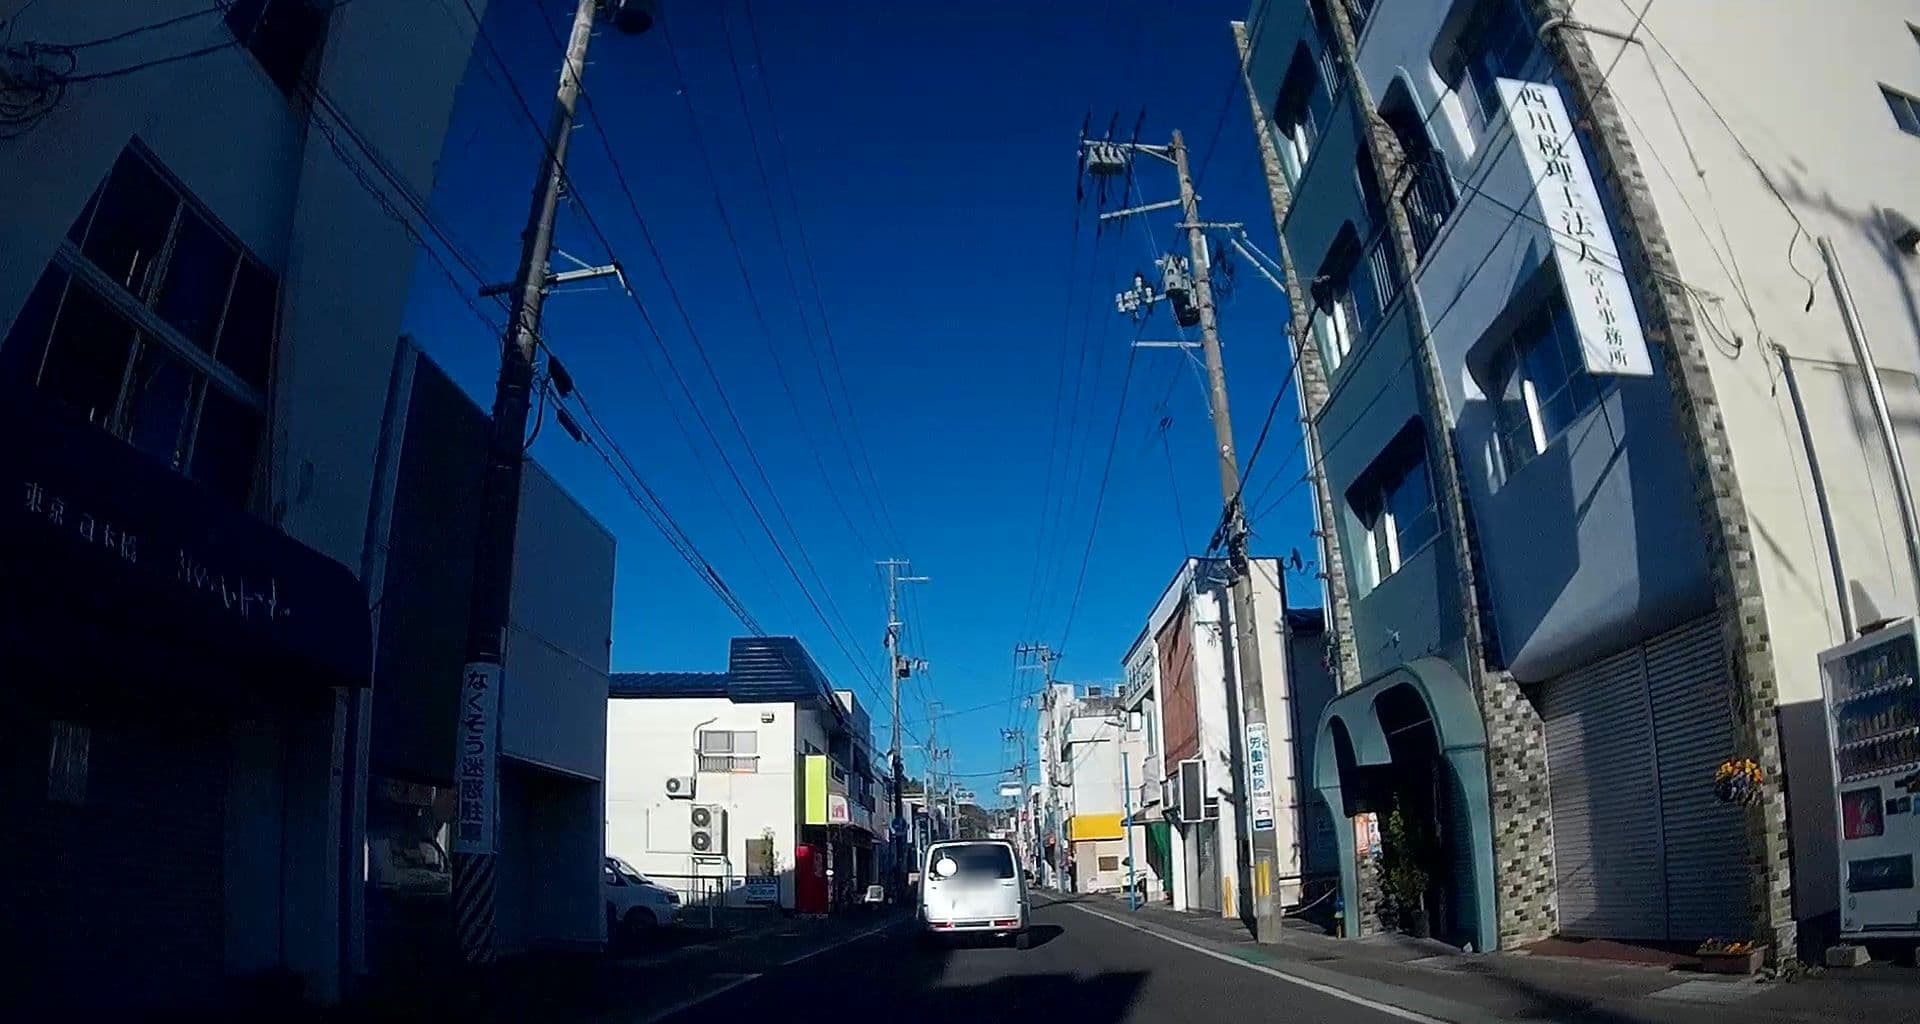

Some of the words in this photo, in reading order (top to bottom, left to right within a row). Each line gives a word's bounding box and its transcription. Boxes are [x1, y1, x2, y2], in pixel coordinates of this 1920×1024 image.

[1520, 87, 1606, 265] 西川税理士法人
